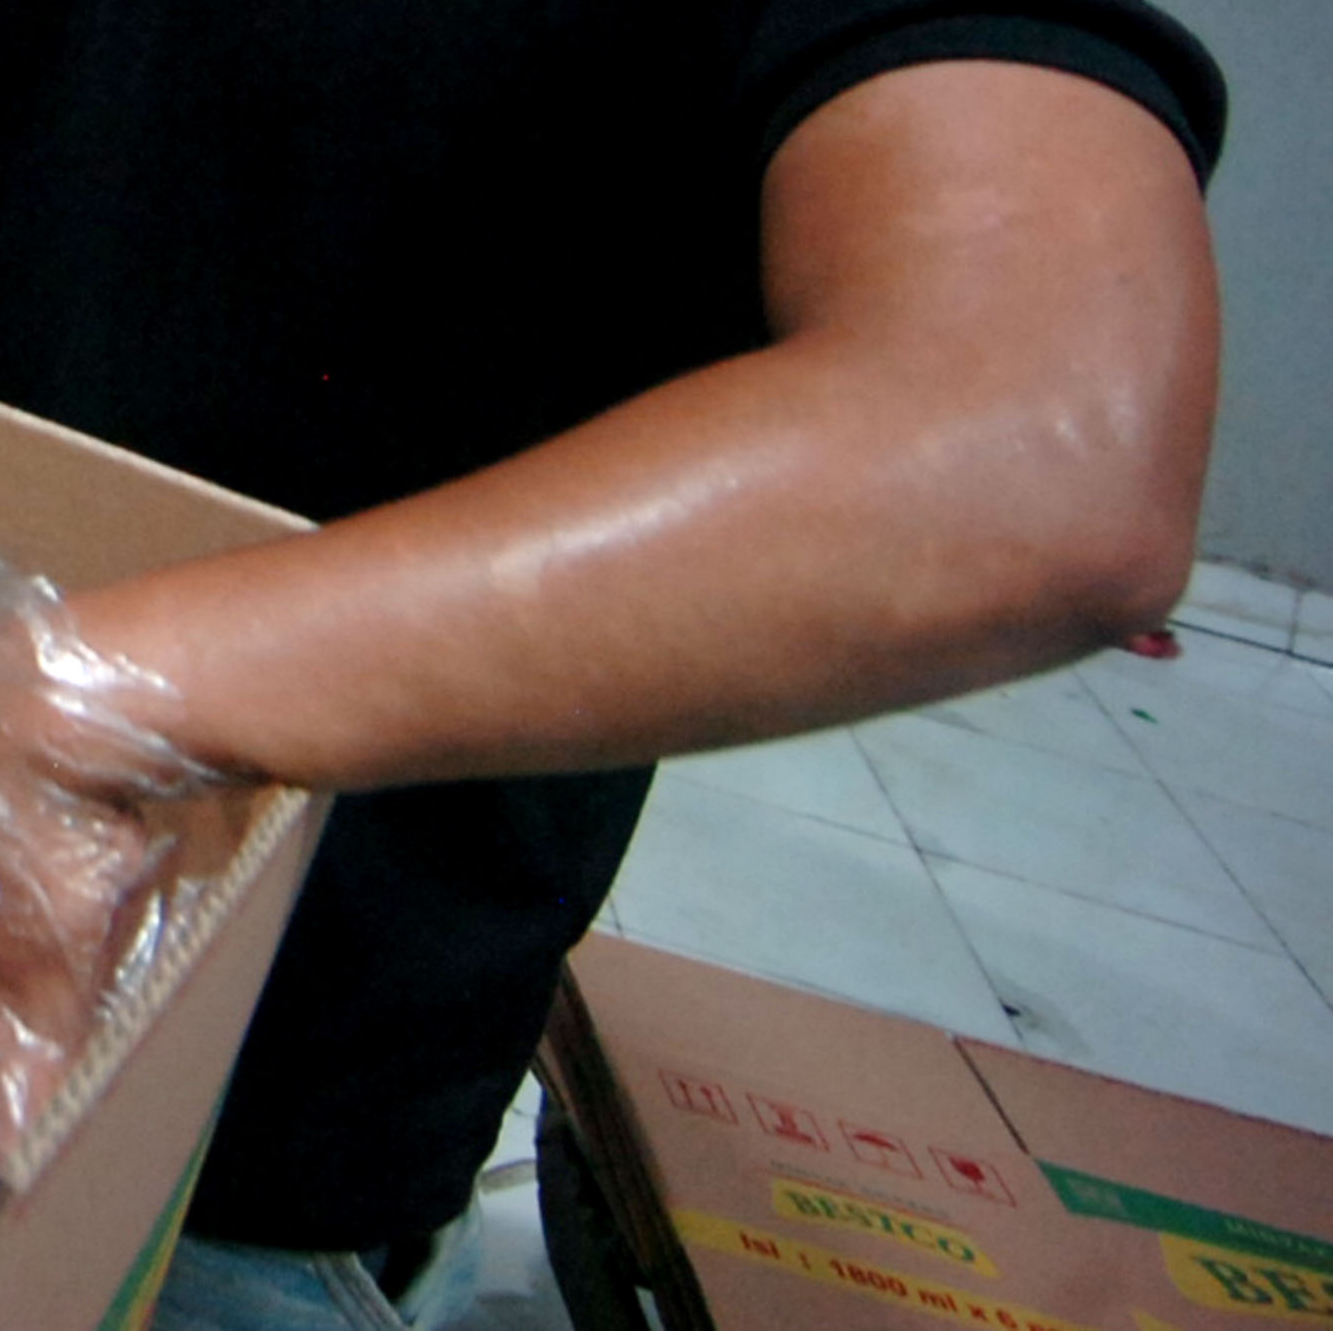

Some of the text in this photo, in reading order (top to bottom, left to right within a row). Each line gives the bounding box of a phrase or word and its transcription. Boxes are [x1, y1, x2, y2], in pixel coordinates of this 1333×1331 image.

[785, 1190, 976, 1262] BESTCO
[830, 1259, 908, 1297] 1800
[918, 1290, 957, 1313] ml
